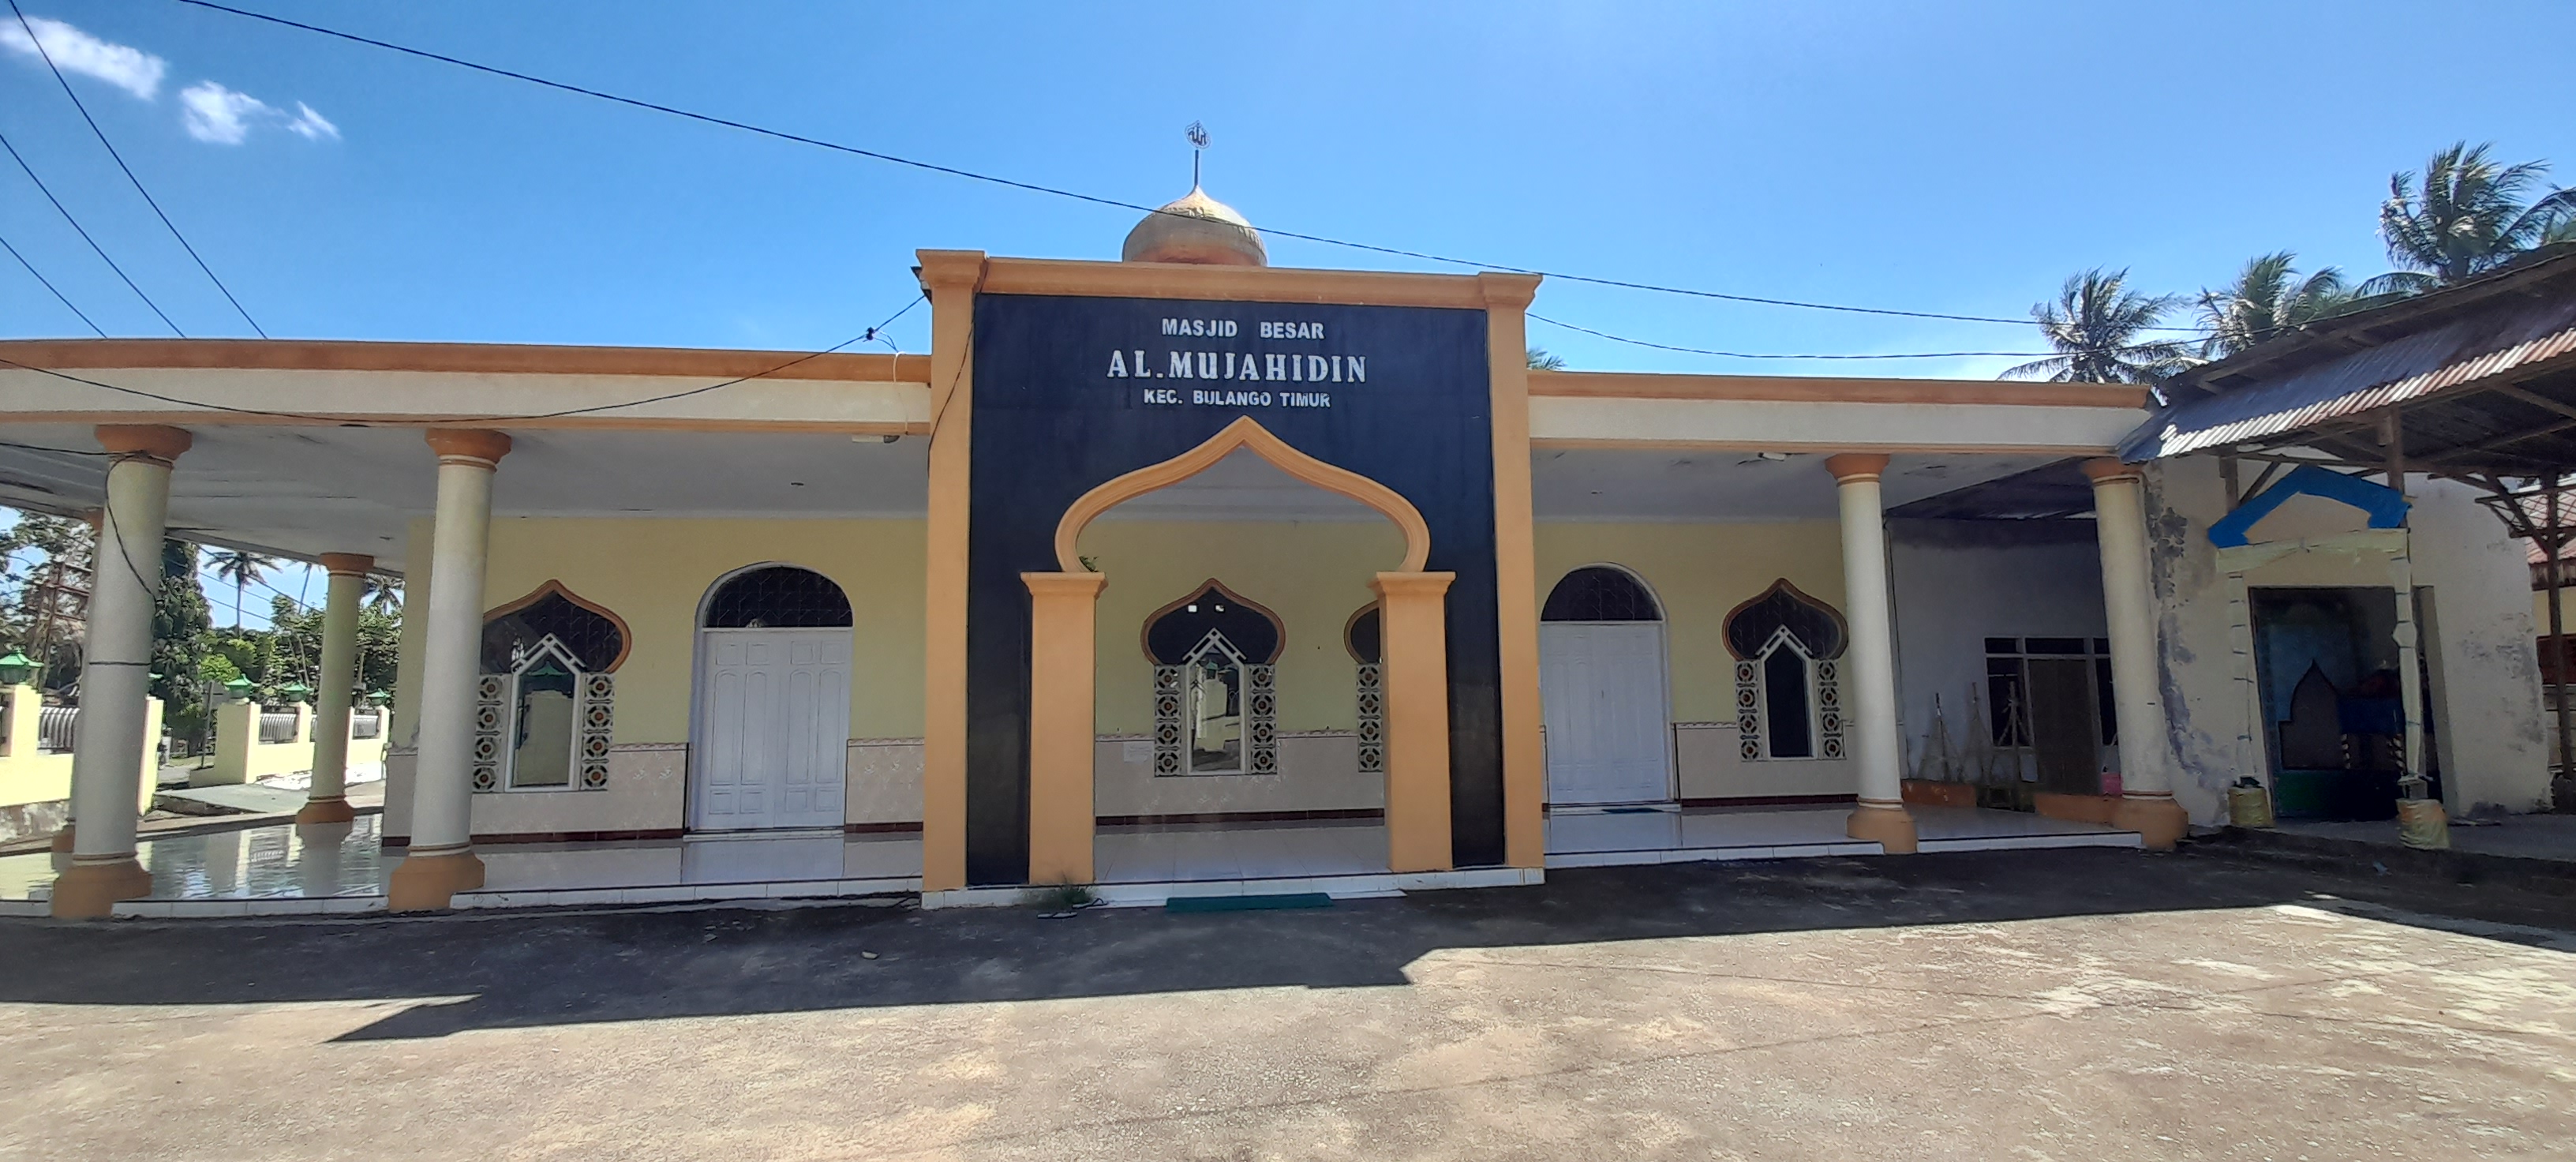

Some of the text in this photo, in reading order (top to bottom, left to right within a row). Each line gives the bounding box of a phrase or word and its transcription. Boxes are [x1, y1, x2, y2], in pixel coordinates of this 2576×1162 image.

[1162, 318, 1325, 339] MASJID BESAR
[1106, 350, 1367, 384] AL.MUJAHIDIN
[1144, 388, 1331, 407] KEC. BULANGO TIMUR
